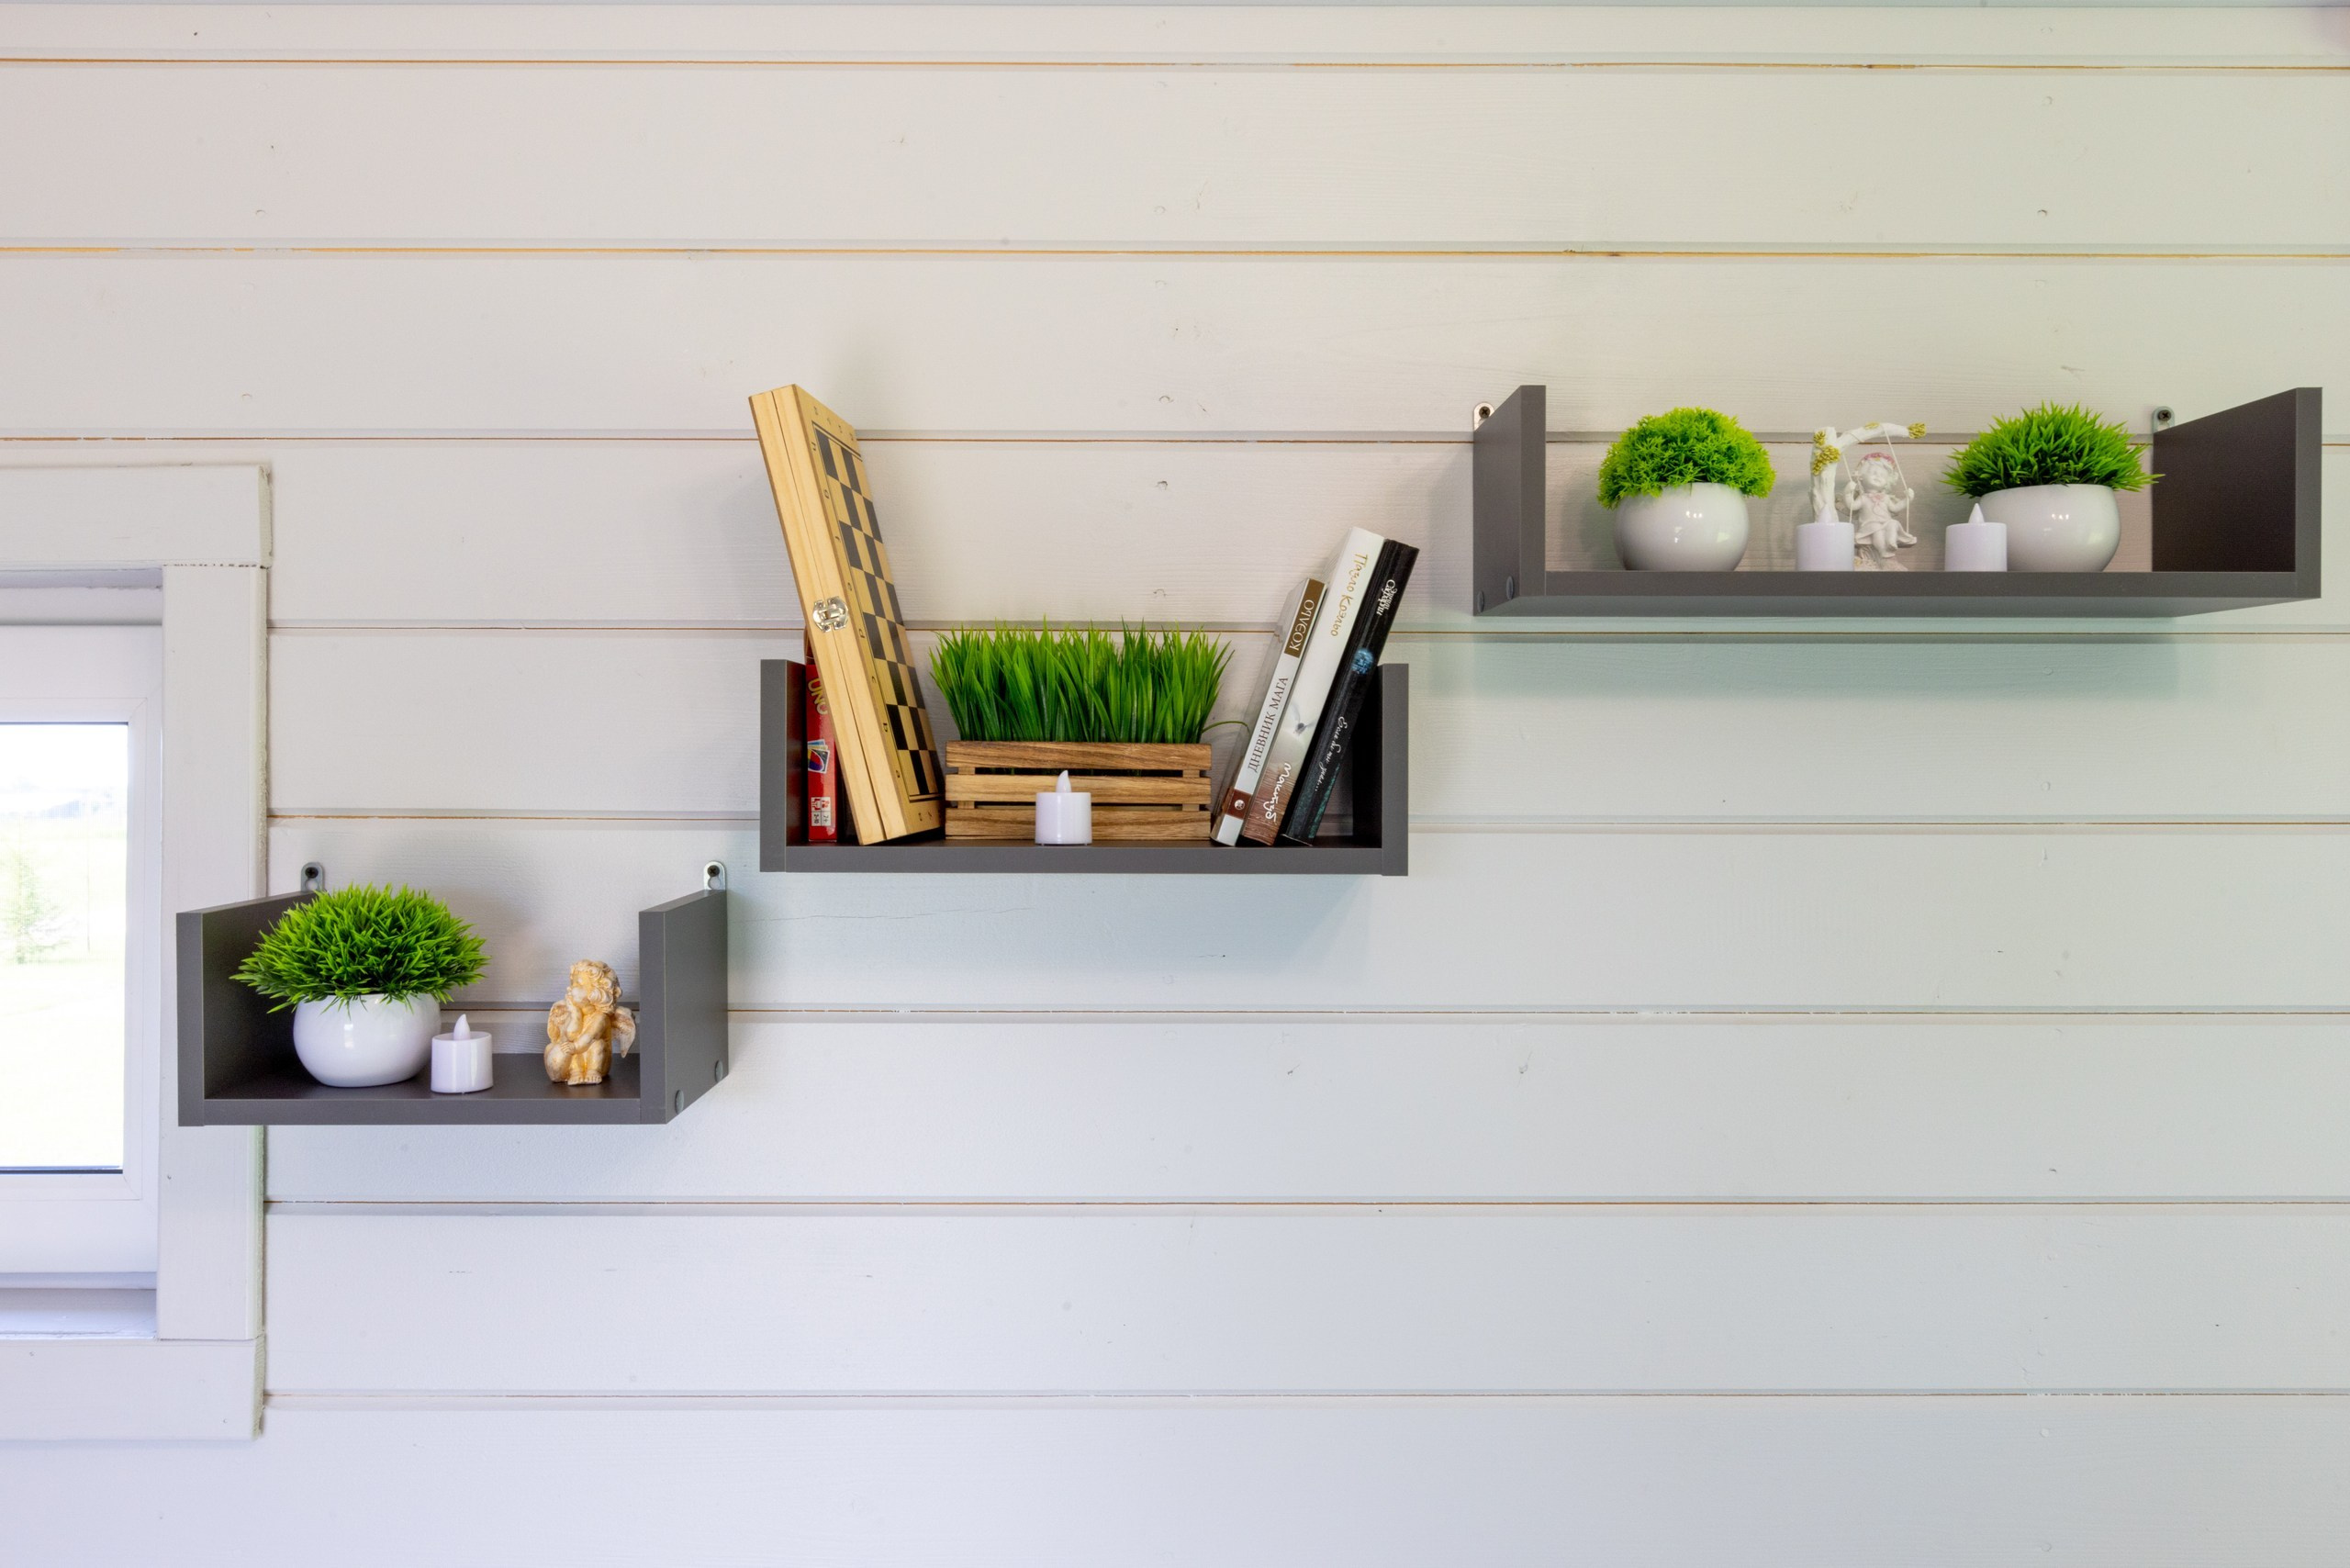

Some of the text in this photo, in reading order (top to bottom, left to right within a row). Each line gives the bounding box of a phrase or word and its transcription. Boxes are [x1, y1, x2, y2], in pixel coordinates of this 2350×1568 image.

[1289, 599, 1315, 651] КОЭЛЬО
[1330, 554, 1368, 636] Пауло Коэльо
[808, 678, 828, 715] UNO
[1247, 677, 1289, 773] ДНЕВНИК МАГА
[1263, 762, 1292, 822] Мактуб
